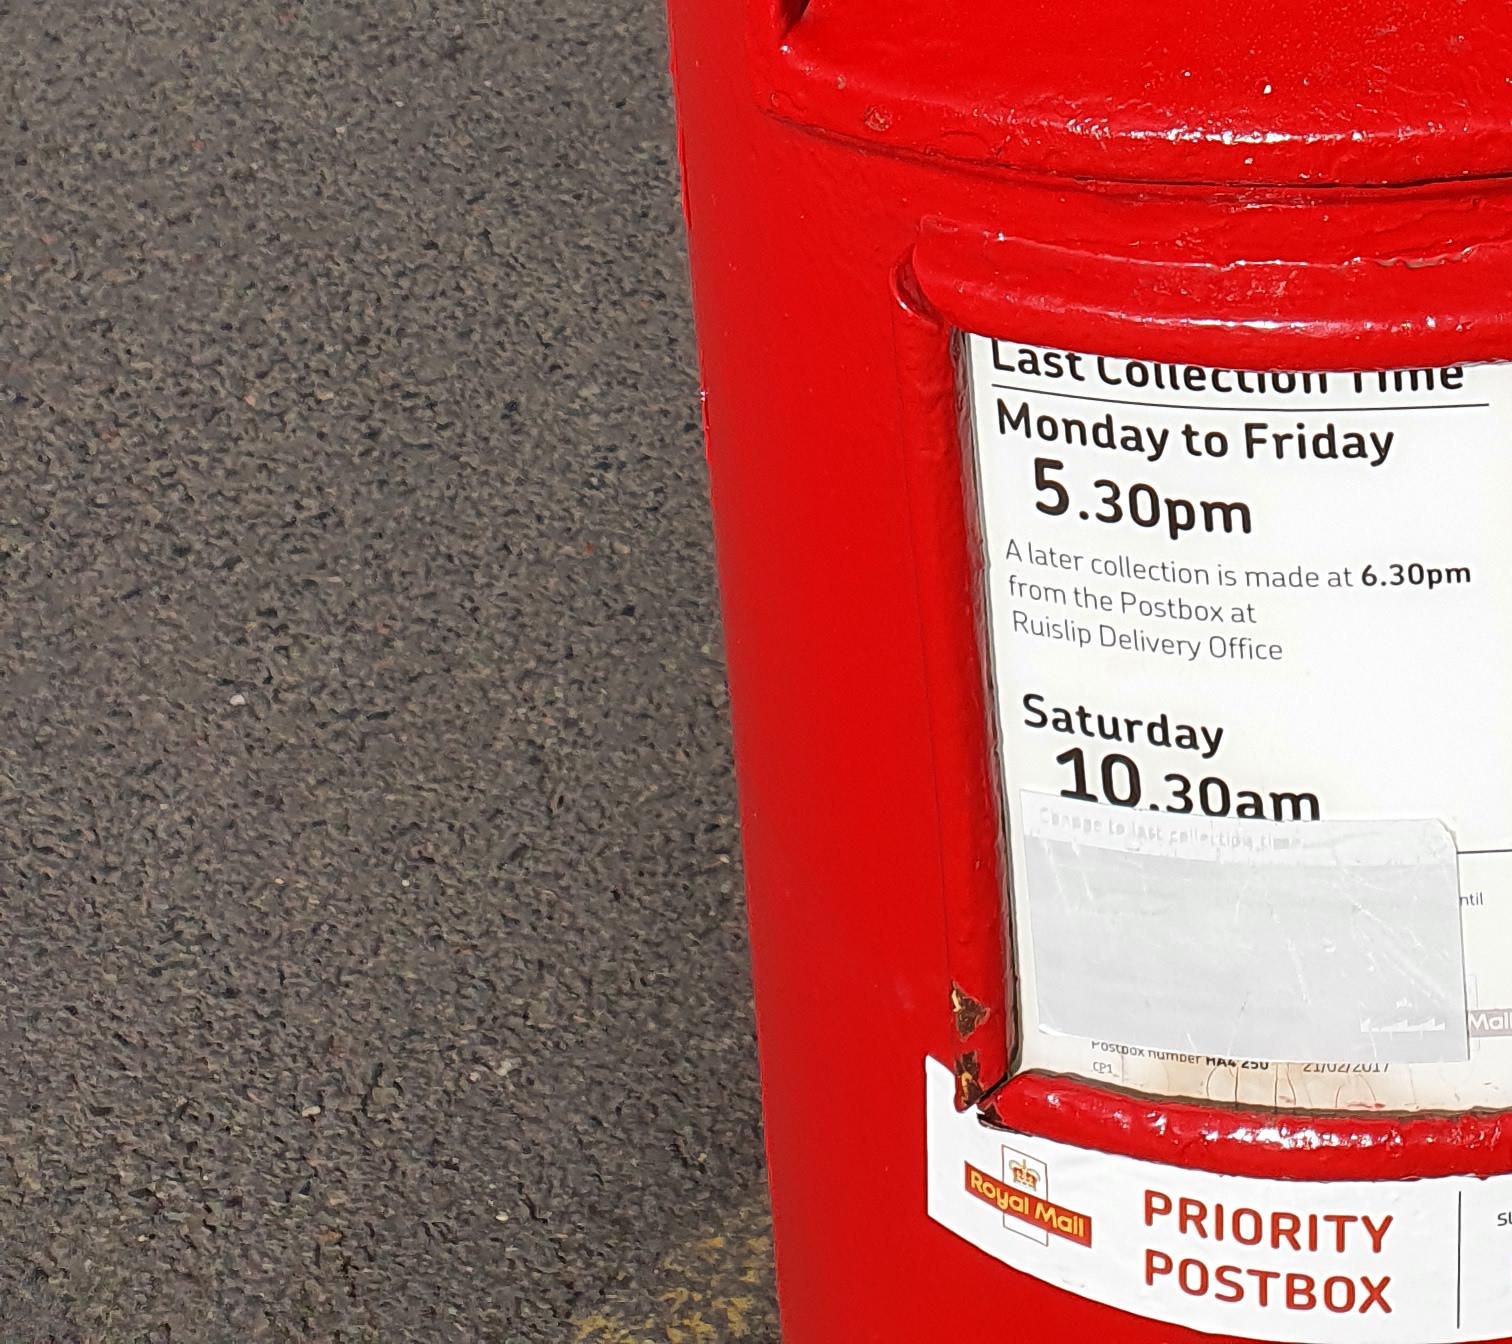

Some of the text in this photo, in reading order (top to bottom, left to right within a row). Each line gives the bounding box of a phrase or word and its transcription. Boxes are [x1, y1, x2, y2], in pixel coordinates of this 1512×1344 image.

[991, 338, 1085, 381] Last
[997, 398, 1394, 467] Monday to Friday
[1034, 457, 1251, 540] 5.30pm
[1006, 539, 1471, 589] A later collection is made at 6.30pm
[1009, 575, 1257, 624] from the Postbox at
[1013, 610, 1283, 661] Ruislip Delivery Office
[1022, 693, 1224, 759] Saturday
[1056, 747, 1320, 821] 10.30am
[1459, 892, 1484, 906] ntil
[970, 1171, 1085, 1238] Royal Mail
[1144, 1189, 1394, 1253] PRIORITY
[1144, 1249, 1392, 1313] POSTBOX
